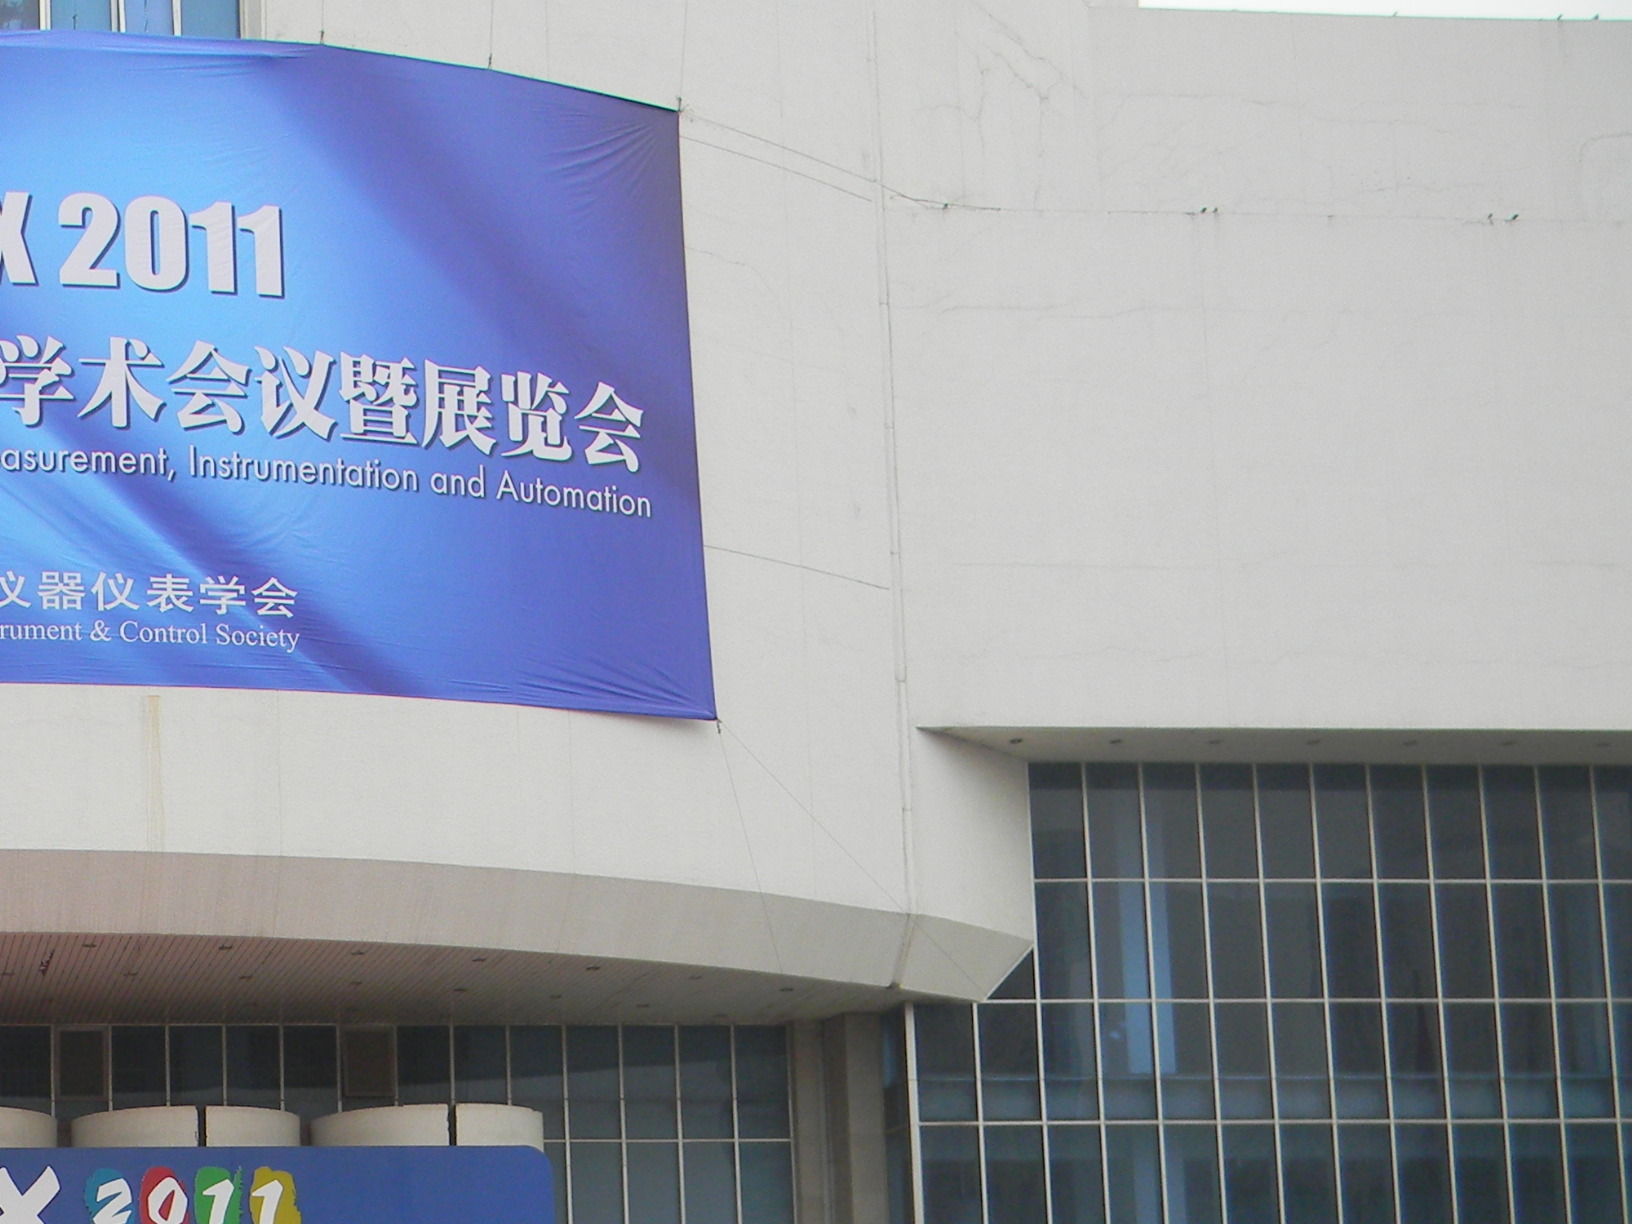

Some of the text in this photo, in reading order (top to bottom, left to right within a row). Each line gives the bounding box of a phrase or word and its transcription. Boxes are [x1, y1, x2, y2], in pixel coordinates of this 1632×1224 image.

[58, 194, 283, 297] 2011
[189, 444, 419, 493] Instrumentation
[430, 464, 485, 498] and
[496, 469, 652, 519] Automation
[89, 620, 112, 642] &
[119, 619, 206, 645] Control
[216, 622, 300, 654] Society
